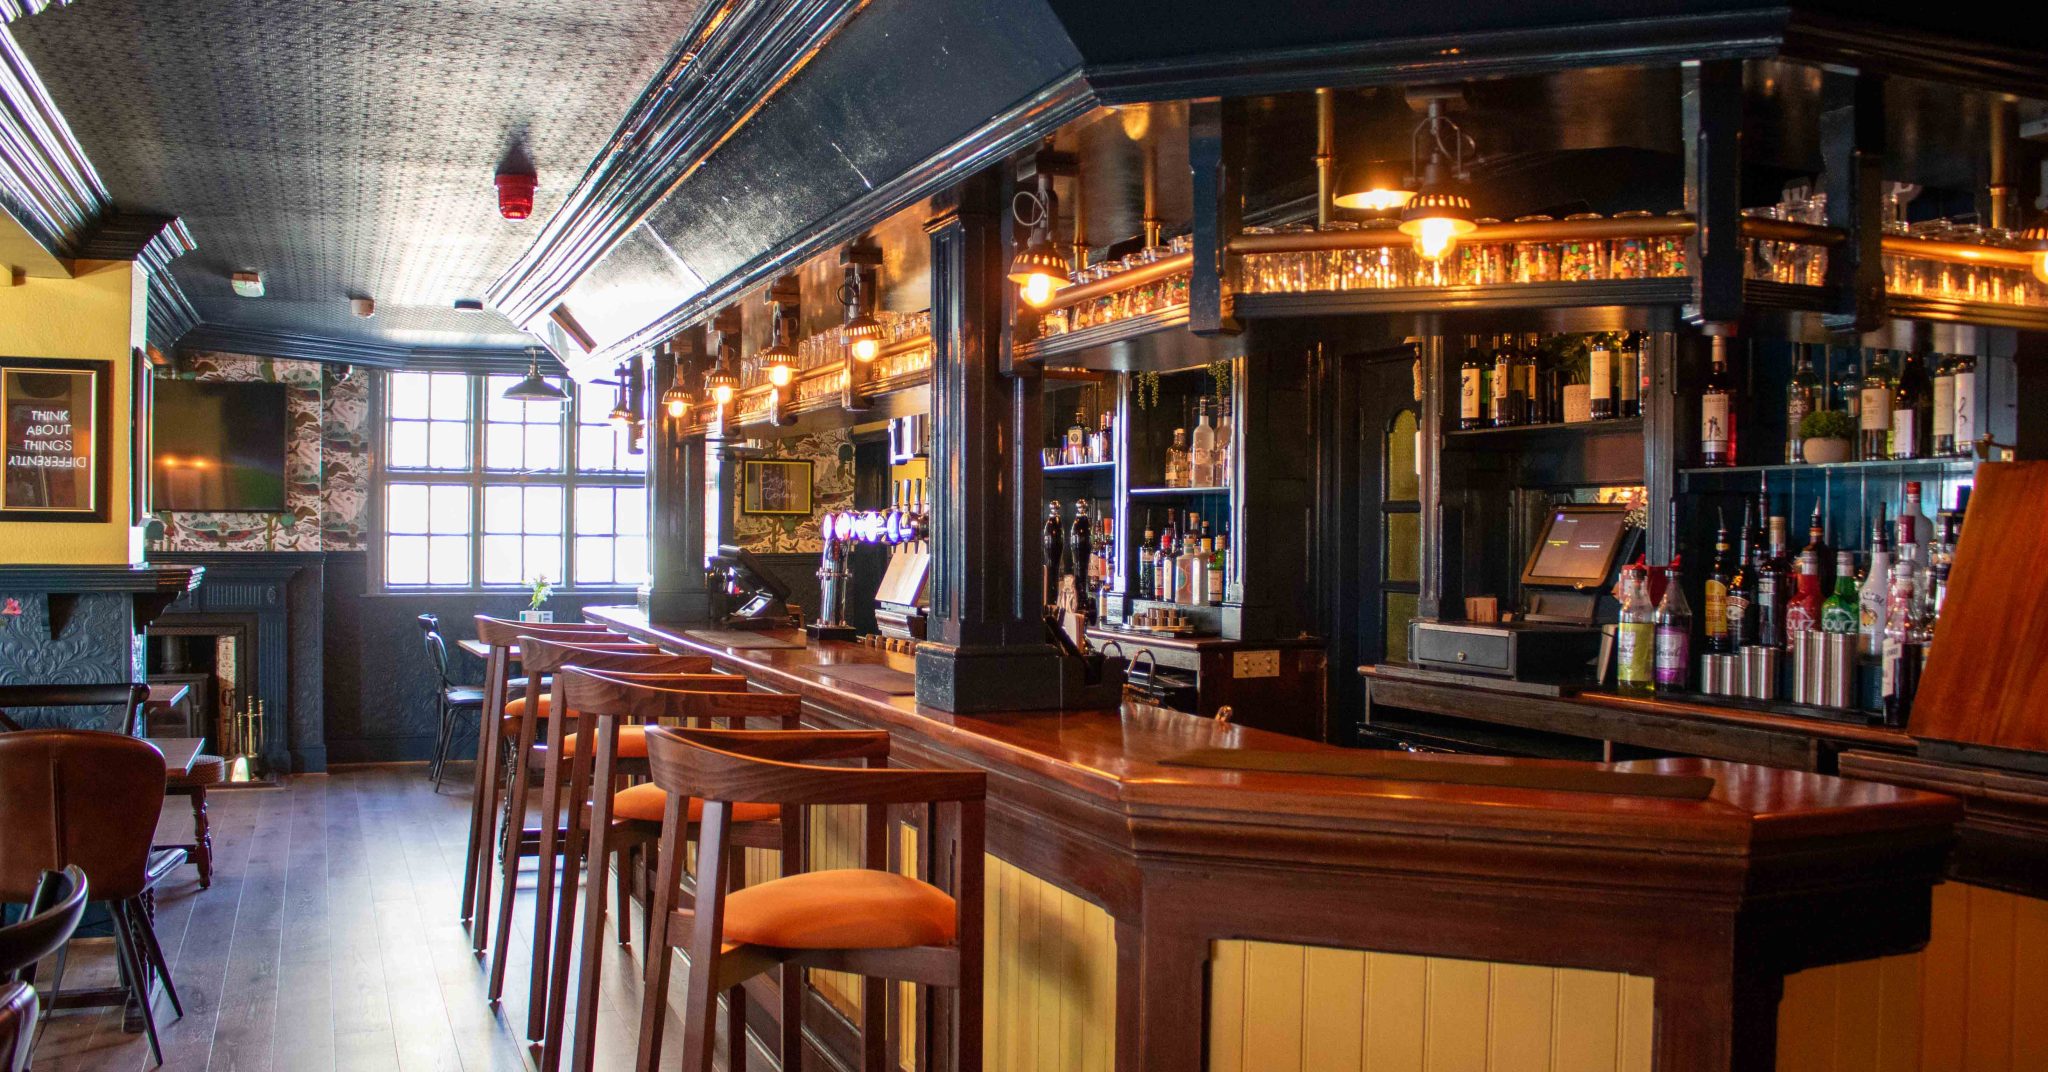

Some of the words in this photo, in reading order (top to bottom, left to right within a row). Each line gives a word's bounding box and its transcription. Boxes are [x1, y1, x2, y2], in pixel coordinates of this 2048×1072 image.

[31, 410, 69, 421] THINK
[26, 424, 72, 435] ABOUT
[23, 439, 73, 451] THINGS
[8, 455, 87, 468] DIFFERENTLY
[1786, 619, 1815, 630] ourz
